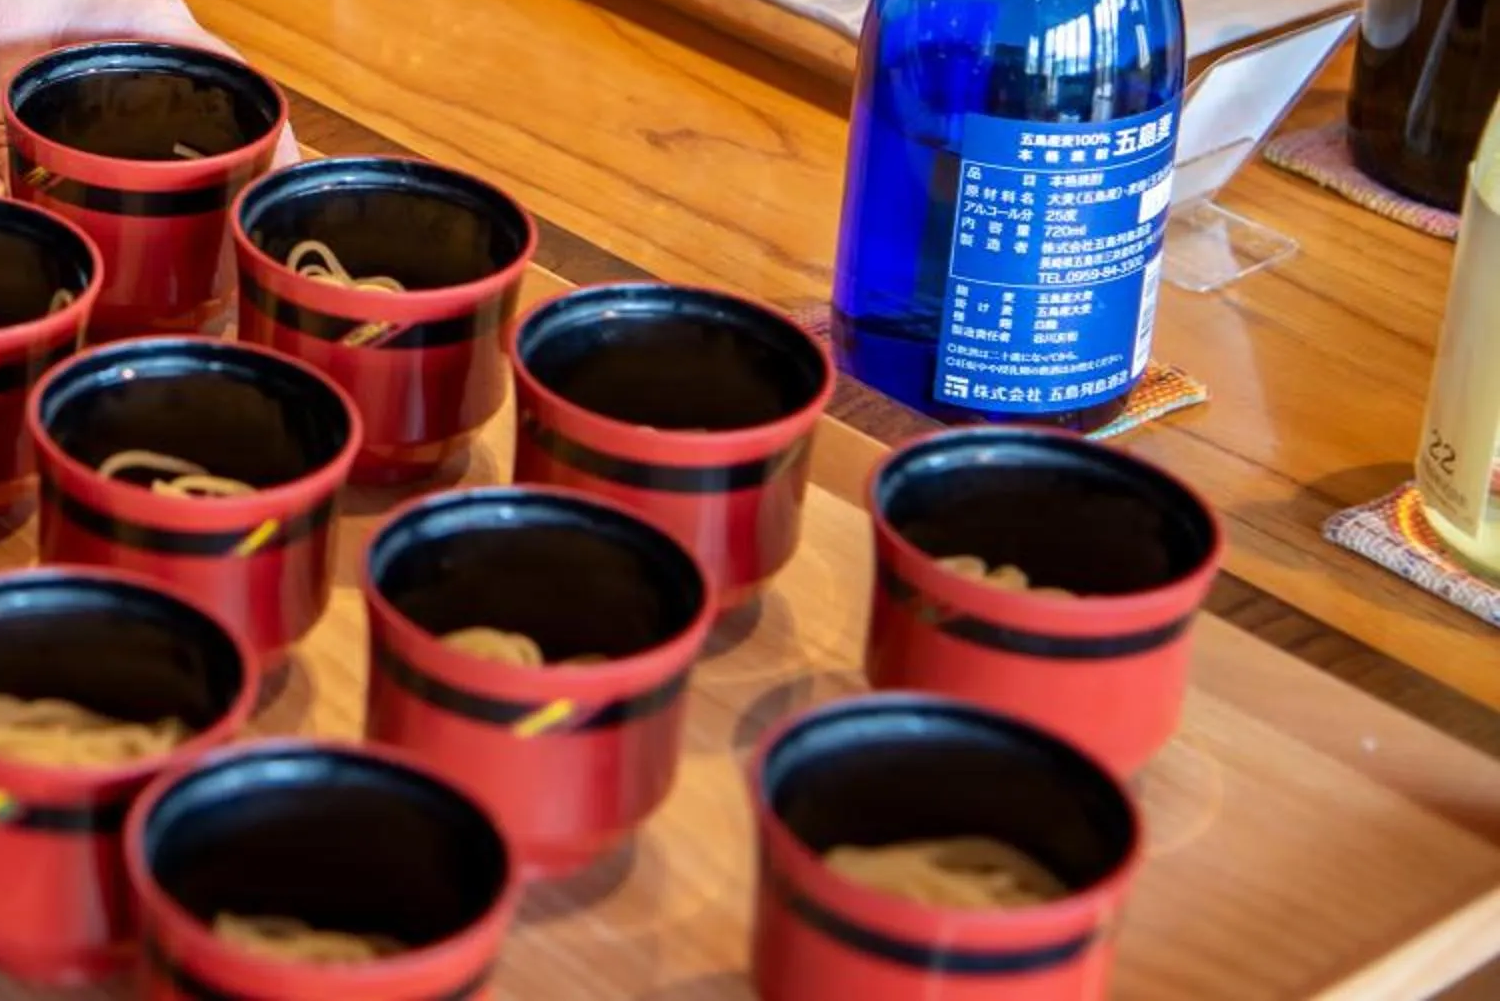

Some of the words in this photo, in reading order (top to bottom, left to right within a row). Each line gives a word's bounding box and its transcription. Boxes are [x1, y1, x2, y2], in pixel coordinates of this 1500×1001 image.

[963, 200, 1034, 222] アルコール分
[973, 382, 1042, 403] 株式会社
